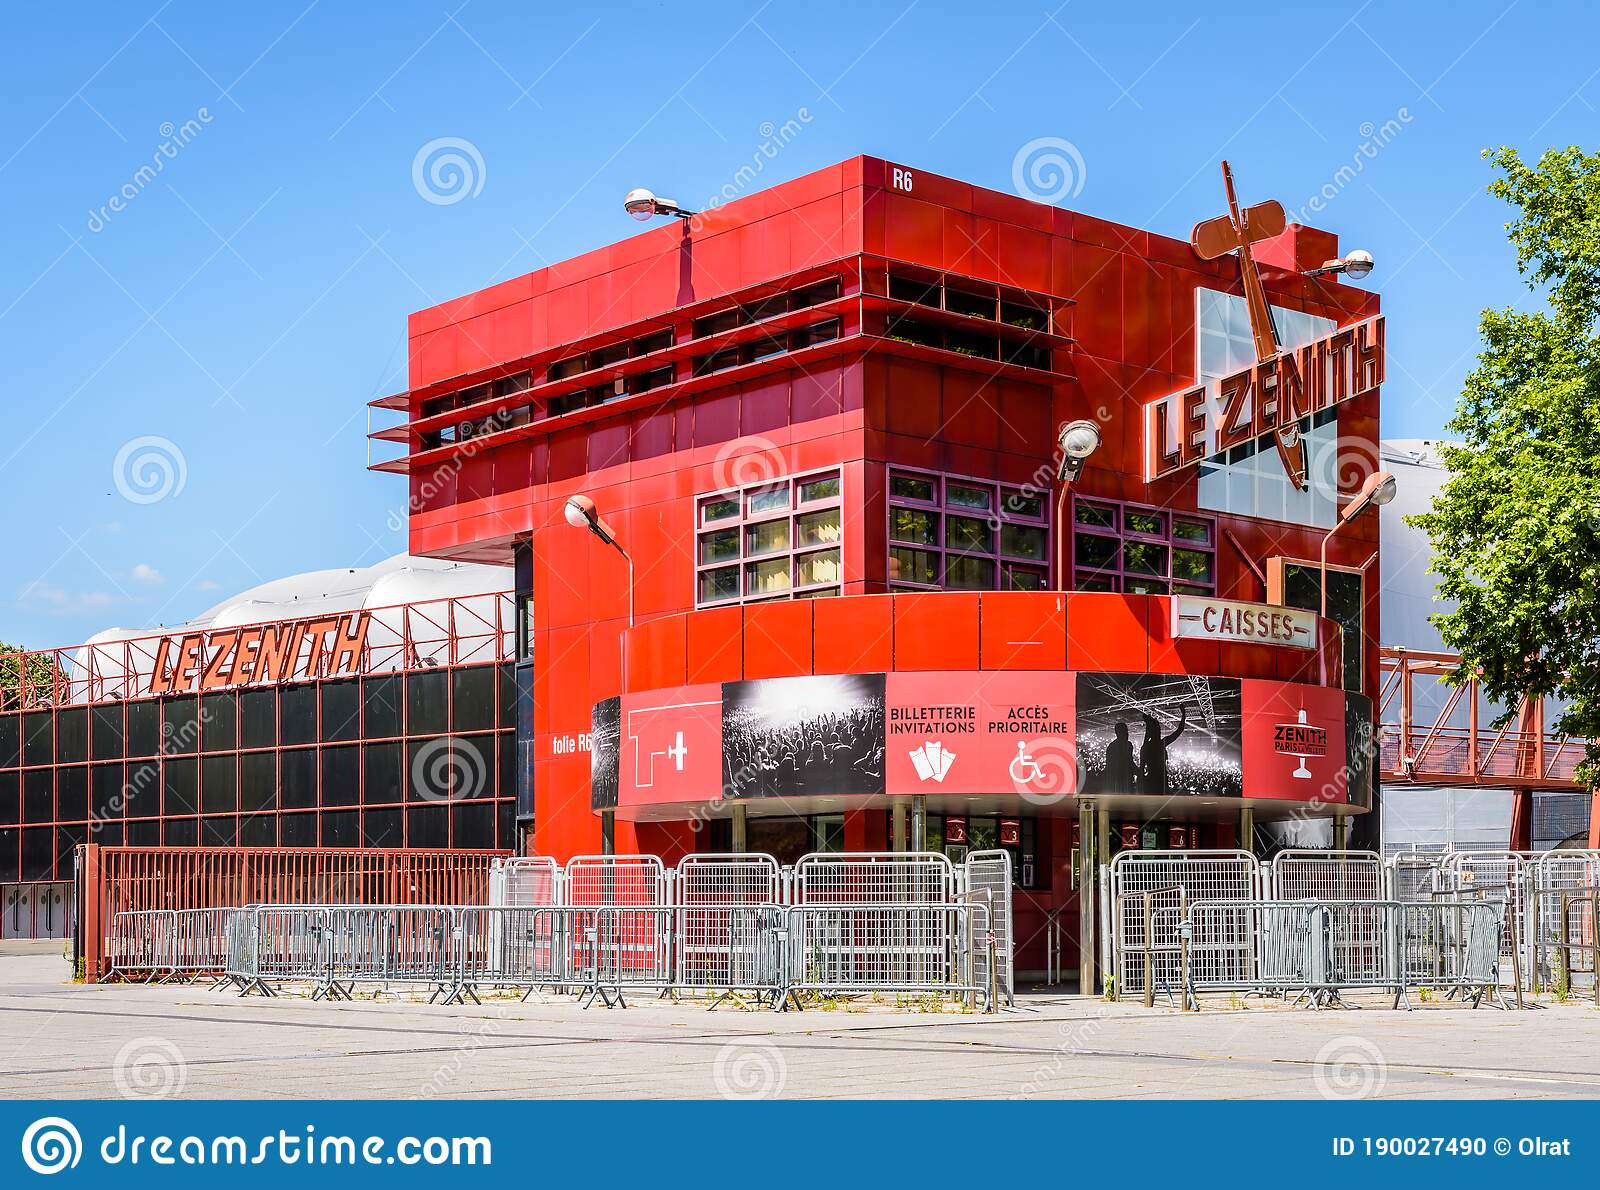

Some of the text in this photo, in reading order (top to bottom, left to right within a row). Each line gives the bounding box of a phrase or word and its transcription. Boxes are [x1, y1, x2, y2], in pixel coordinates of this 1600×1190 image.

[893, 167, 913, 192] R6
[1151, 316, 1386, 478] LE ZENITH
[202, 611, 372, 689] ZENITH
[890, 706, 976, 720] BILLETTERIE
[1007, 704, 1049, 719] ACCÈS
[890, 721, 976, 734] INVITATIONS
[988, 721, 1068, 734] PRIORITAIRE
[1274, 726, 1327, 745] ZENITH
[553, 733, 592, 755] folie R6
[1274, 741, 1298, 753] PARIS
[957, 828, 965, 839] 2
[1012, 830, 1018, 841] 3
[1132, 834, 1138, 847] 5
[1179, 835, 1185, 846] 6
